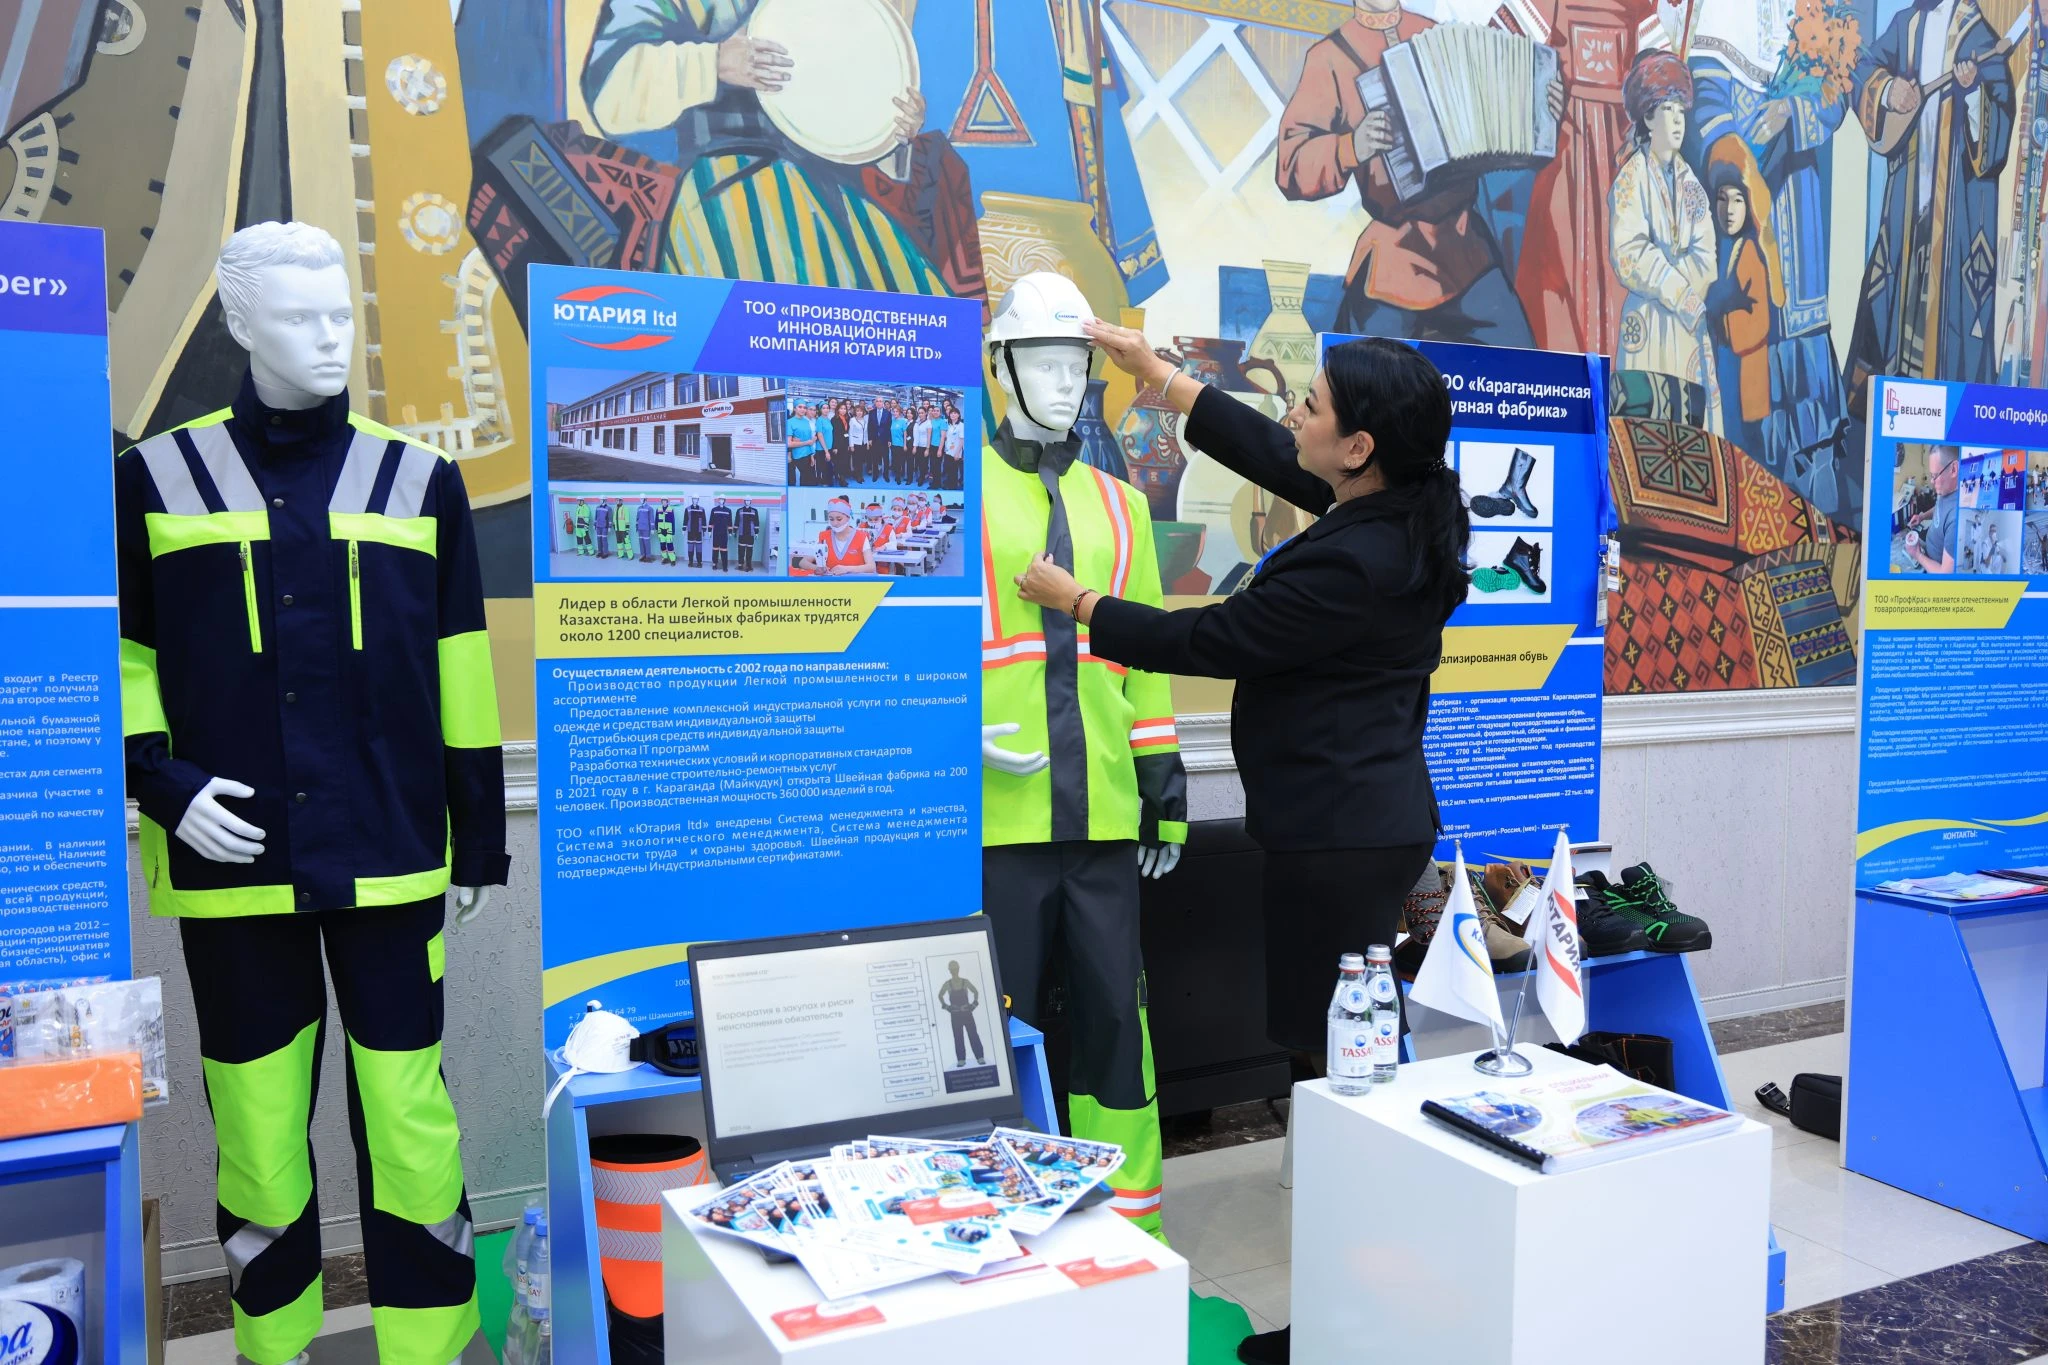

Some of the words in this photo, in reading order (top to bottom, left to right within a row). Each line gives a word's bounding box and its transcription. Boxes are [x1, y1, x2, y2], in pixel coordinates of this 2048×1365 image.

[554, 304, 645, 324] ЮТАРИЯ
[654, 310, 676, 326] ltd
[744, 301, 776, 315] ТОО
[781, 304, 946, 327] «ПРОИЗВОДСТВЕННАЯ
[778, 320, 916, 342] ИННОВАЦИОННАЯ
[750, 336, 839, 354] КОМПАНИЯ
[845, 342, 905, 357] ЮТАРИЯ
[910, 346, 942, 359] LTD»
[1442, 373, 1464, 391] ОО
[1468, 376, 1591, 399] «Карагандинская
[1451, 400, 1493, 416] увная
[1497, 400, 1568, 420] фабрика»
[1900, 406, 1942, 417] BELLATONE
[1974, 404, 1997, 420] ТОО
[559, 598, 605, 611] Лидер
[611, 600, 617, 608] в
[622, 597, 677, 608] области
[681, 596, 729, 608] Легкой
[734, 598, 851, 609] промышленности
[1875, 596, 1889, 604] ТОО
[1874, 605, 1951, 614] товаропроизводителем
[1952, 606, 1975, 614] красок.
[560, 614, 642, 625] Казахстана.
[648, 613, 664, 624] На
[669, 612, 732, 624] швейных
[737, 611, 800, 625] фабриках
[804, 614, 859, 624] трудятся
[560, 633, 603, 642] около
[608, 629, 640, 640] 1200
[645, 630, 743, 641] специалистов.
[1519, 651, 1548, 664] обувь
[553, 668, 643, 680] Осуществляем
[645, 666, 725, 677] деятельность
[735, 663, 761, 673] 2002
[763, 664, 788, 674] года
[806, 662, 888, 673] направлениям:
[4, 676, 42, 684] входит
[62, 674, 99, 683] Реестр
[569, 681, 661, 693] Производство
[669, 679, 737, 689] продукции
[744, 675, 786, 686] Легкой
[794, 674, 897, 686] промышленности
[917, 673, 967, 682] широком
[45, 685, 98, 694] получила
[17, 697, 56, 705] второе
[554, 695, 636, 706] ассортименте
[570, 707, 668, 720] Предоставление
[674, 702, 749, 714] комплексной
[754, 698, 843, 712] индустриальной
[847, 700, 880, 709] услуги
[901, 694, 967, 706] специальной
[28, 726, 100, 736] направление
[554, 723, 600, 733] одежде
[612, 720, 673, 731] средствам
[676, 715, 772, 728] индивидуальной
[775, 714, 815, 724] защиты
[46, 737, 91, 745] поэтому
[569, 733, 658, 747] Дистрибьюция
[661, 732, 705, 742] средств
[707, 727, 801, 740] индивидуальной
[804, 726, 844, 735] защиты
[570, 747, 637, 759] Разработка
[640, 745, 649, 754] IT
[652, 744, 709, 756] программ
[570, 760, 637, 772] Разработка
[639, 757, 710, 767] технических
[713, 754, 758, 766] условий
[760, 754, 767, 762] и
[769, 750, 852, 762] корпоративных
[854, 747, 912, 757] стандартов
[571, 772, 668, 786] Предоставление
[671, 765, 807, 780] строительно-ремонтных
[809, 763, 837, 774] услуг
[556, 789, 563, 799] В
[569, 787, 596, 798] 2021
[602, 788, 627, 797] году
[656, 783, 715, 794] Караганда
[720, 776, 782, 791] (Майкудук)
[787, 776, 830, 786] открыта
[835, 772, 882, 783] Швейная
[887, 770, 930, 782] фабрика
[950, 767, 967, 776] 200
[556, 802, 607, 812] человек.
[611, 795, 719, 810] Производственная
[721, 792, 777, 802] мощность
[822, 785, 866, 797] изделий
[875, 785, 895, 794] год.
[58, 809, 104, 817] качеству
[556, 828, 582, 838] ТОО
[590, 825, 621, 836] «ПИК
[629, 824, 680, 834] «Ютария
[688, 819, 708, 830] ltd»
[716, 818, 772, 828] внедрены
[778, 814, 823, 824] Система
[830, 808, 903, 820] менеджмента
[922, 805, 967, 814] качества,
[557, 841, 613, 852] Система
[622, 833, 724, 848] экологического
[732, 826, 823, 839] менеджмента,
[831, 822, 880, 832] Система
[887, 816, 967, 828] менеджмента
[1942, 830, 1978, 840] КОНТАКТЫ:
[59, 850, 106, 859] Наличие
[557, 852, 639, 865] безопасности
[645, 850, 677, 860] труда
[704, 845, 745, 856] охраны
[752, 840, 804, 852] здоровья.
[811, 836, 858, 846] Швейная
[865, 832, 919, 844] продукция
[936, 829, 967, 839] услуги
[558, 865, 647, 879] подтверждены
[650, 856, 755, 872] Индустриальными
[757, 850, 843, 864] сертификатами.
[62, 881, 106, 891] средств,
[5, 896, 32, 904] всей
[40, 892, 107, 903] продукции,
[75, 921, 99, 930] 2012
[16, 956, 66, 966] область),
[72, 953, 98, 963] офис
[716, 1007, 774, 1021] Бюрократия
[782, 1002, 818, 1014] закупах
[827, 998, 854, 1010] риски
[718, 1018, 783, 1032] неисполнения
[784, 1010, 844, 1025] обязательств
[1374, 1036, 1398, 1046] ASSA
